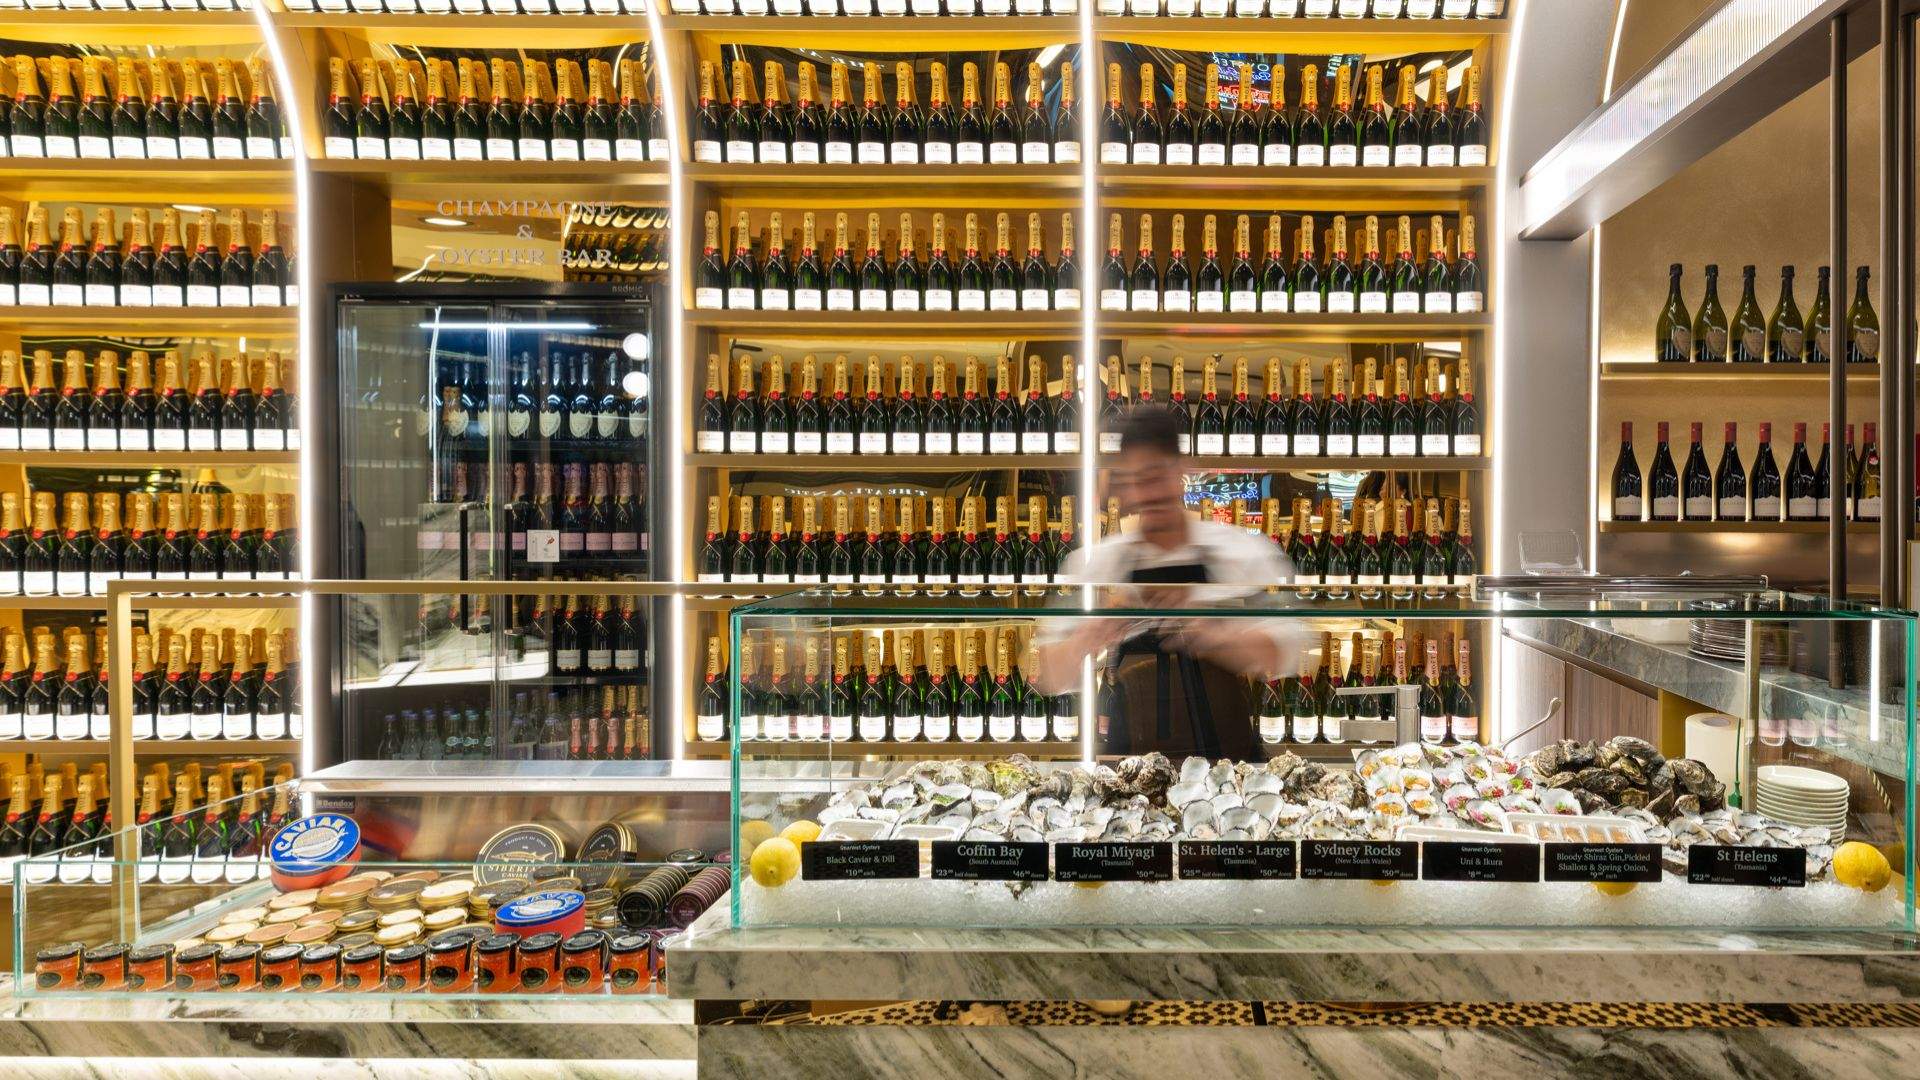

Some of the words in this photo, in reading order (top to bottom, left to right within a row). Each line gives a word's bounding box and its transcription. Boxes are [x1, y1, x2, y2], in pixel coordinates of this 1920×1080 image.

[437, 200, 617, 216] CHAMPAGNE
[516, 224, 535, 240] &
[438, 249, 544, 265] OYSTER
[560, 249, 612, 265] BAR
[275, 816, 346, 851] CAVIAR
[957, 844, 998, 857] Coffin
[1000, 845, 1024, 861] Bay
[1072, 846, 1108, 860] Royal
[1112, 845, 1155, 860] Miyagi
[1181, 845, 1197, 856] St.
[1201, 845, 1244, 856] Helen's
[1256, 845, 1290, 858] Large
[1314, 844, 1360, 858] Sydney
[1364, 845, 1402, 856] Rocks
[1556, 853, 1582, 862] Bloody
[1584, 853, 1607, 862] Shiraz
[1717, 850, 1731, 861] St
[1734, 850, 1778, 862] Helens
[826, 856, 846, 864] Black
[882, 855, 895, 863] Dill
[1483, 858, 1503, 866] Ikura
[1558, 863, 1588, 871] Shallots
[1598, 863, 1622, 872] Spring
